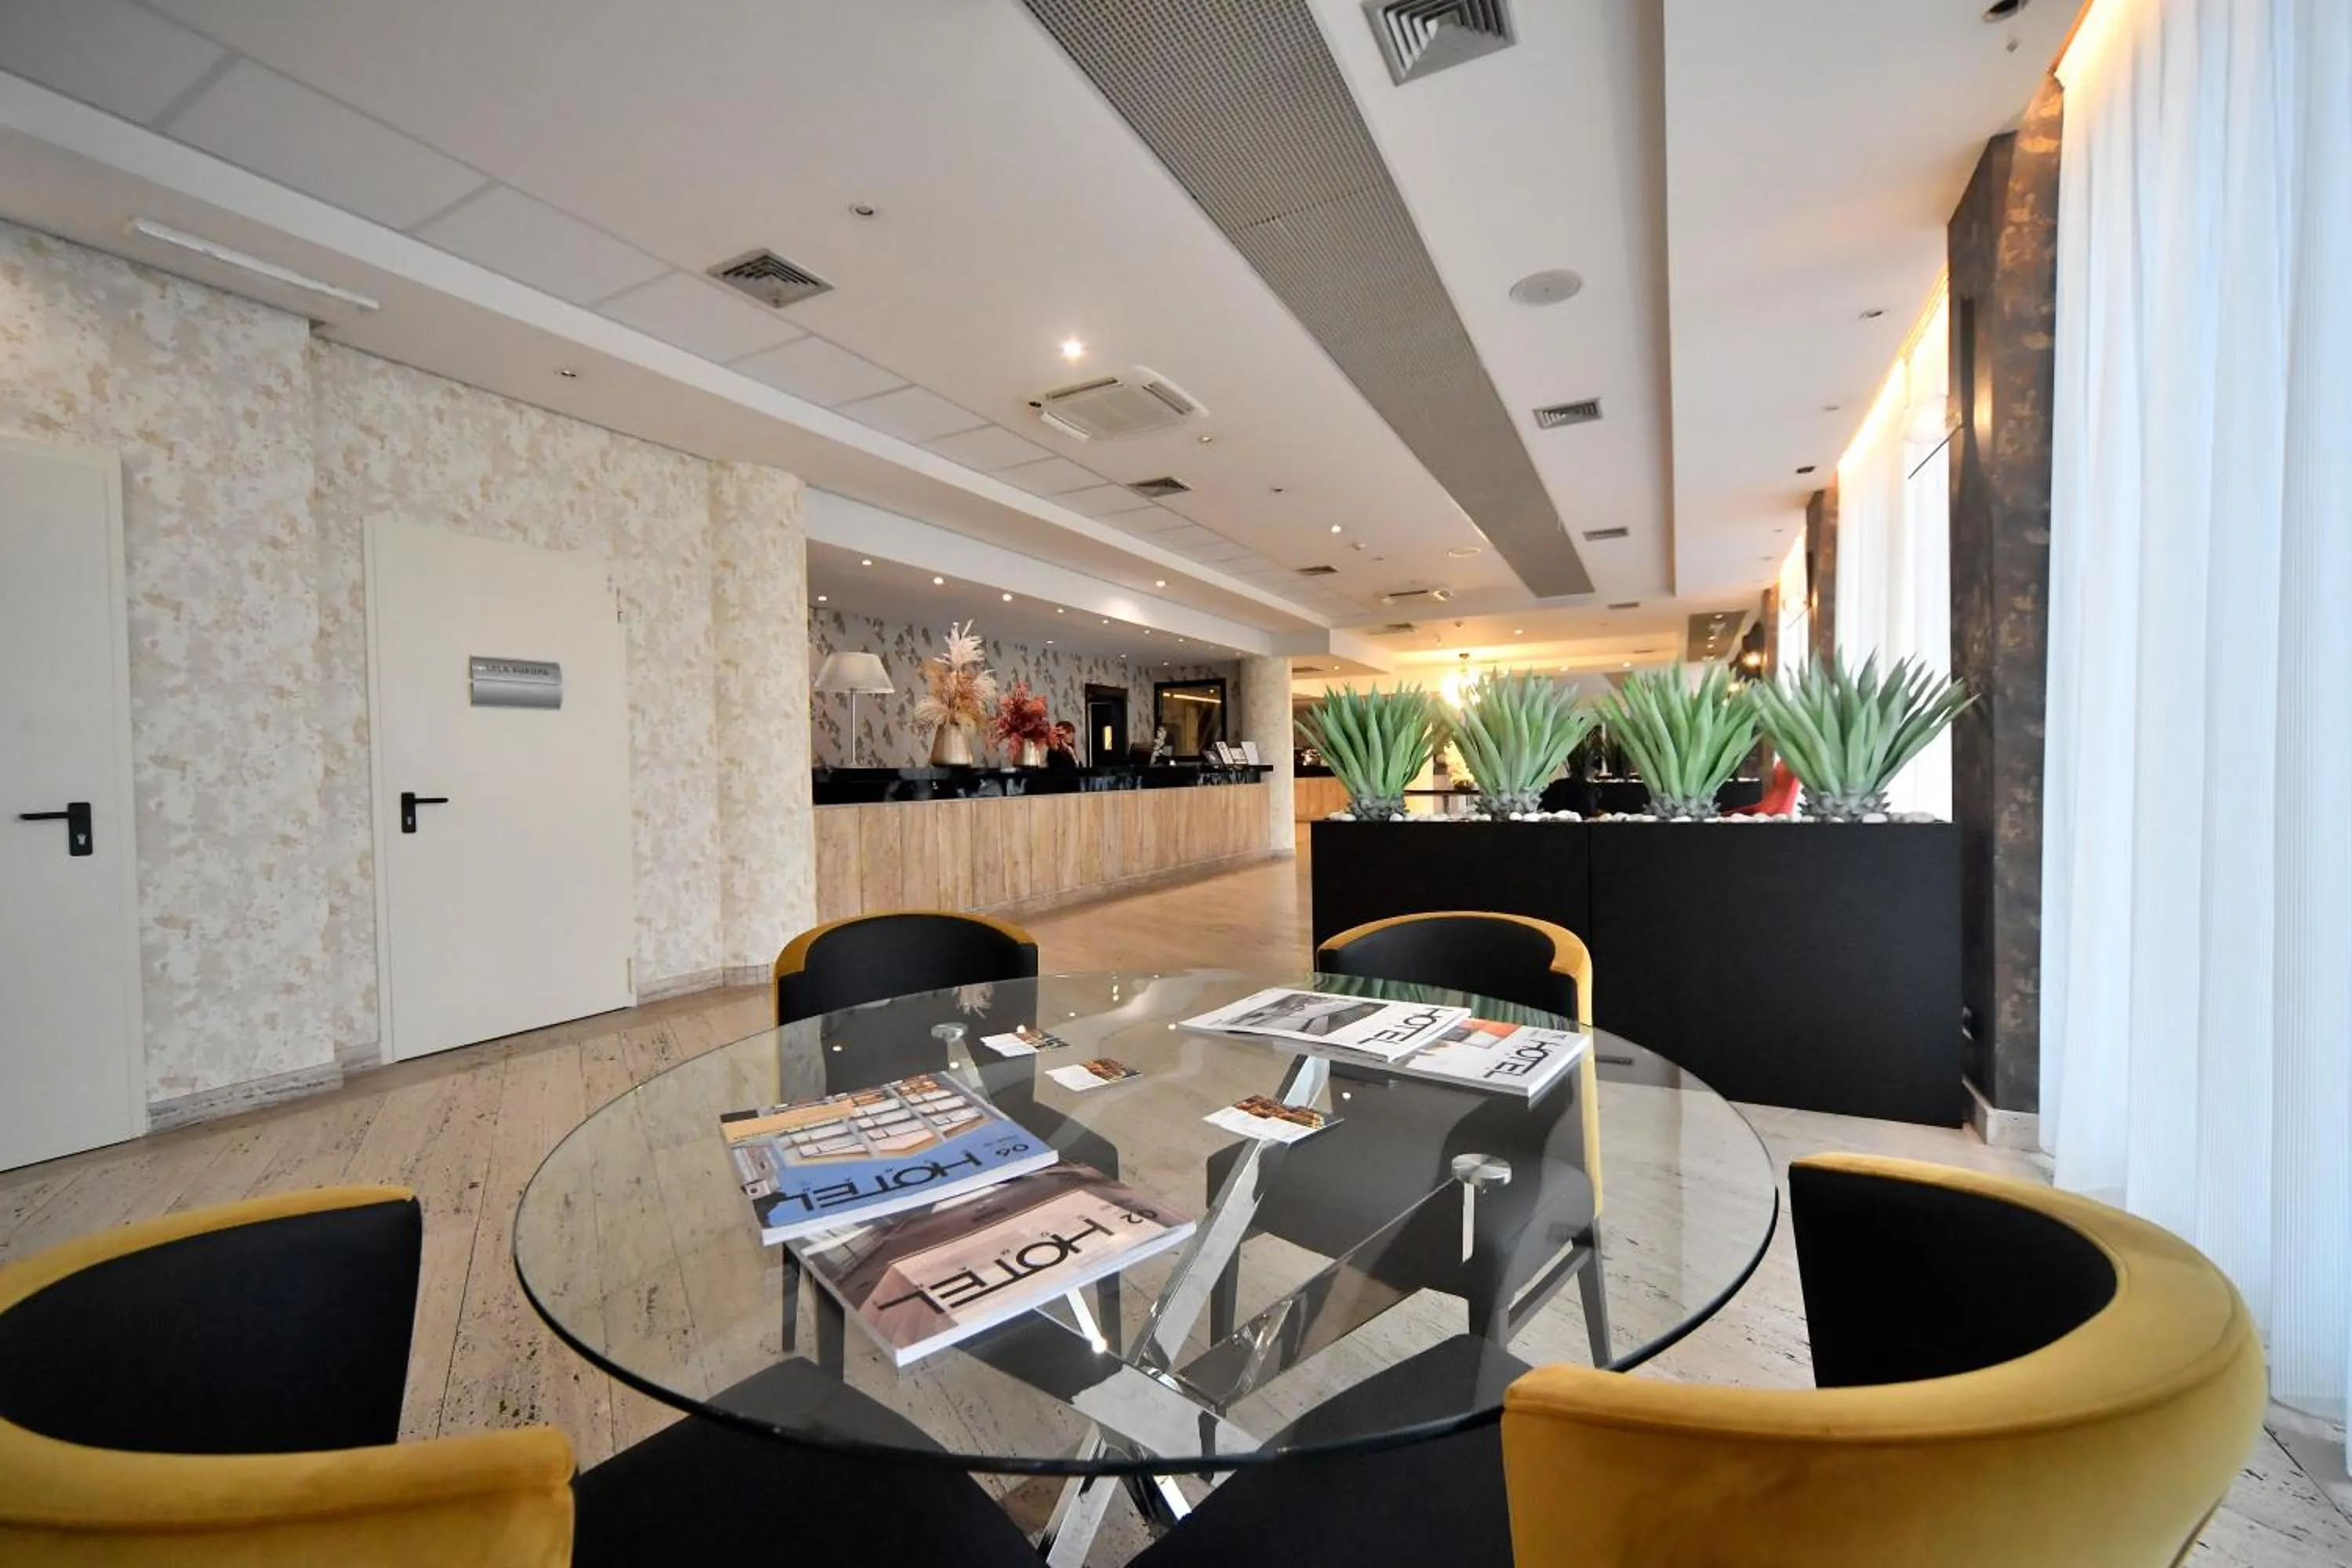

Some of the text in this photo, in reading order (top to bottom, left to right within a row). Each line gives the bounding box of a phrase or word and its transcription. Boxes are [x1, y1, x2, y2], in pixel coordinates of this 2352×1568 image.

[1356, 1007, 1453, 1044] HOTEL
[1483, 1040, 1560, 1079] HOTEL
[782, 1149, 982, 1212] HOTEL
[877, 1218, 1114, 1316] HOTEL
